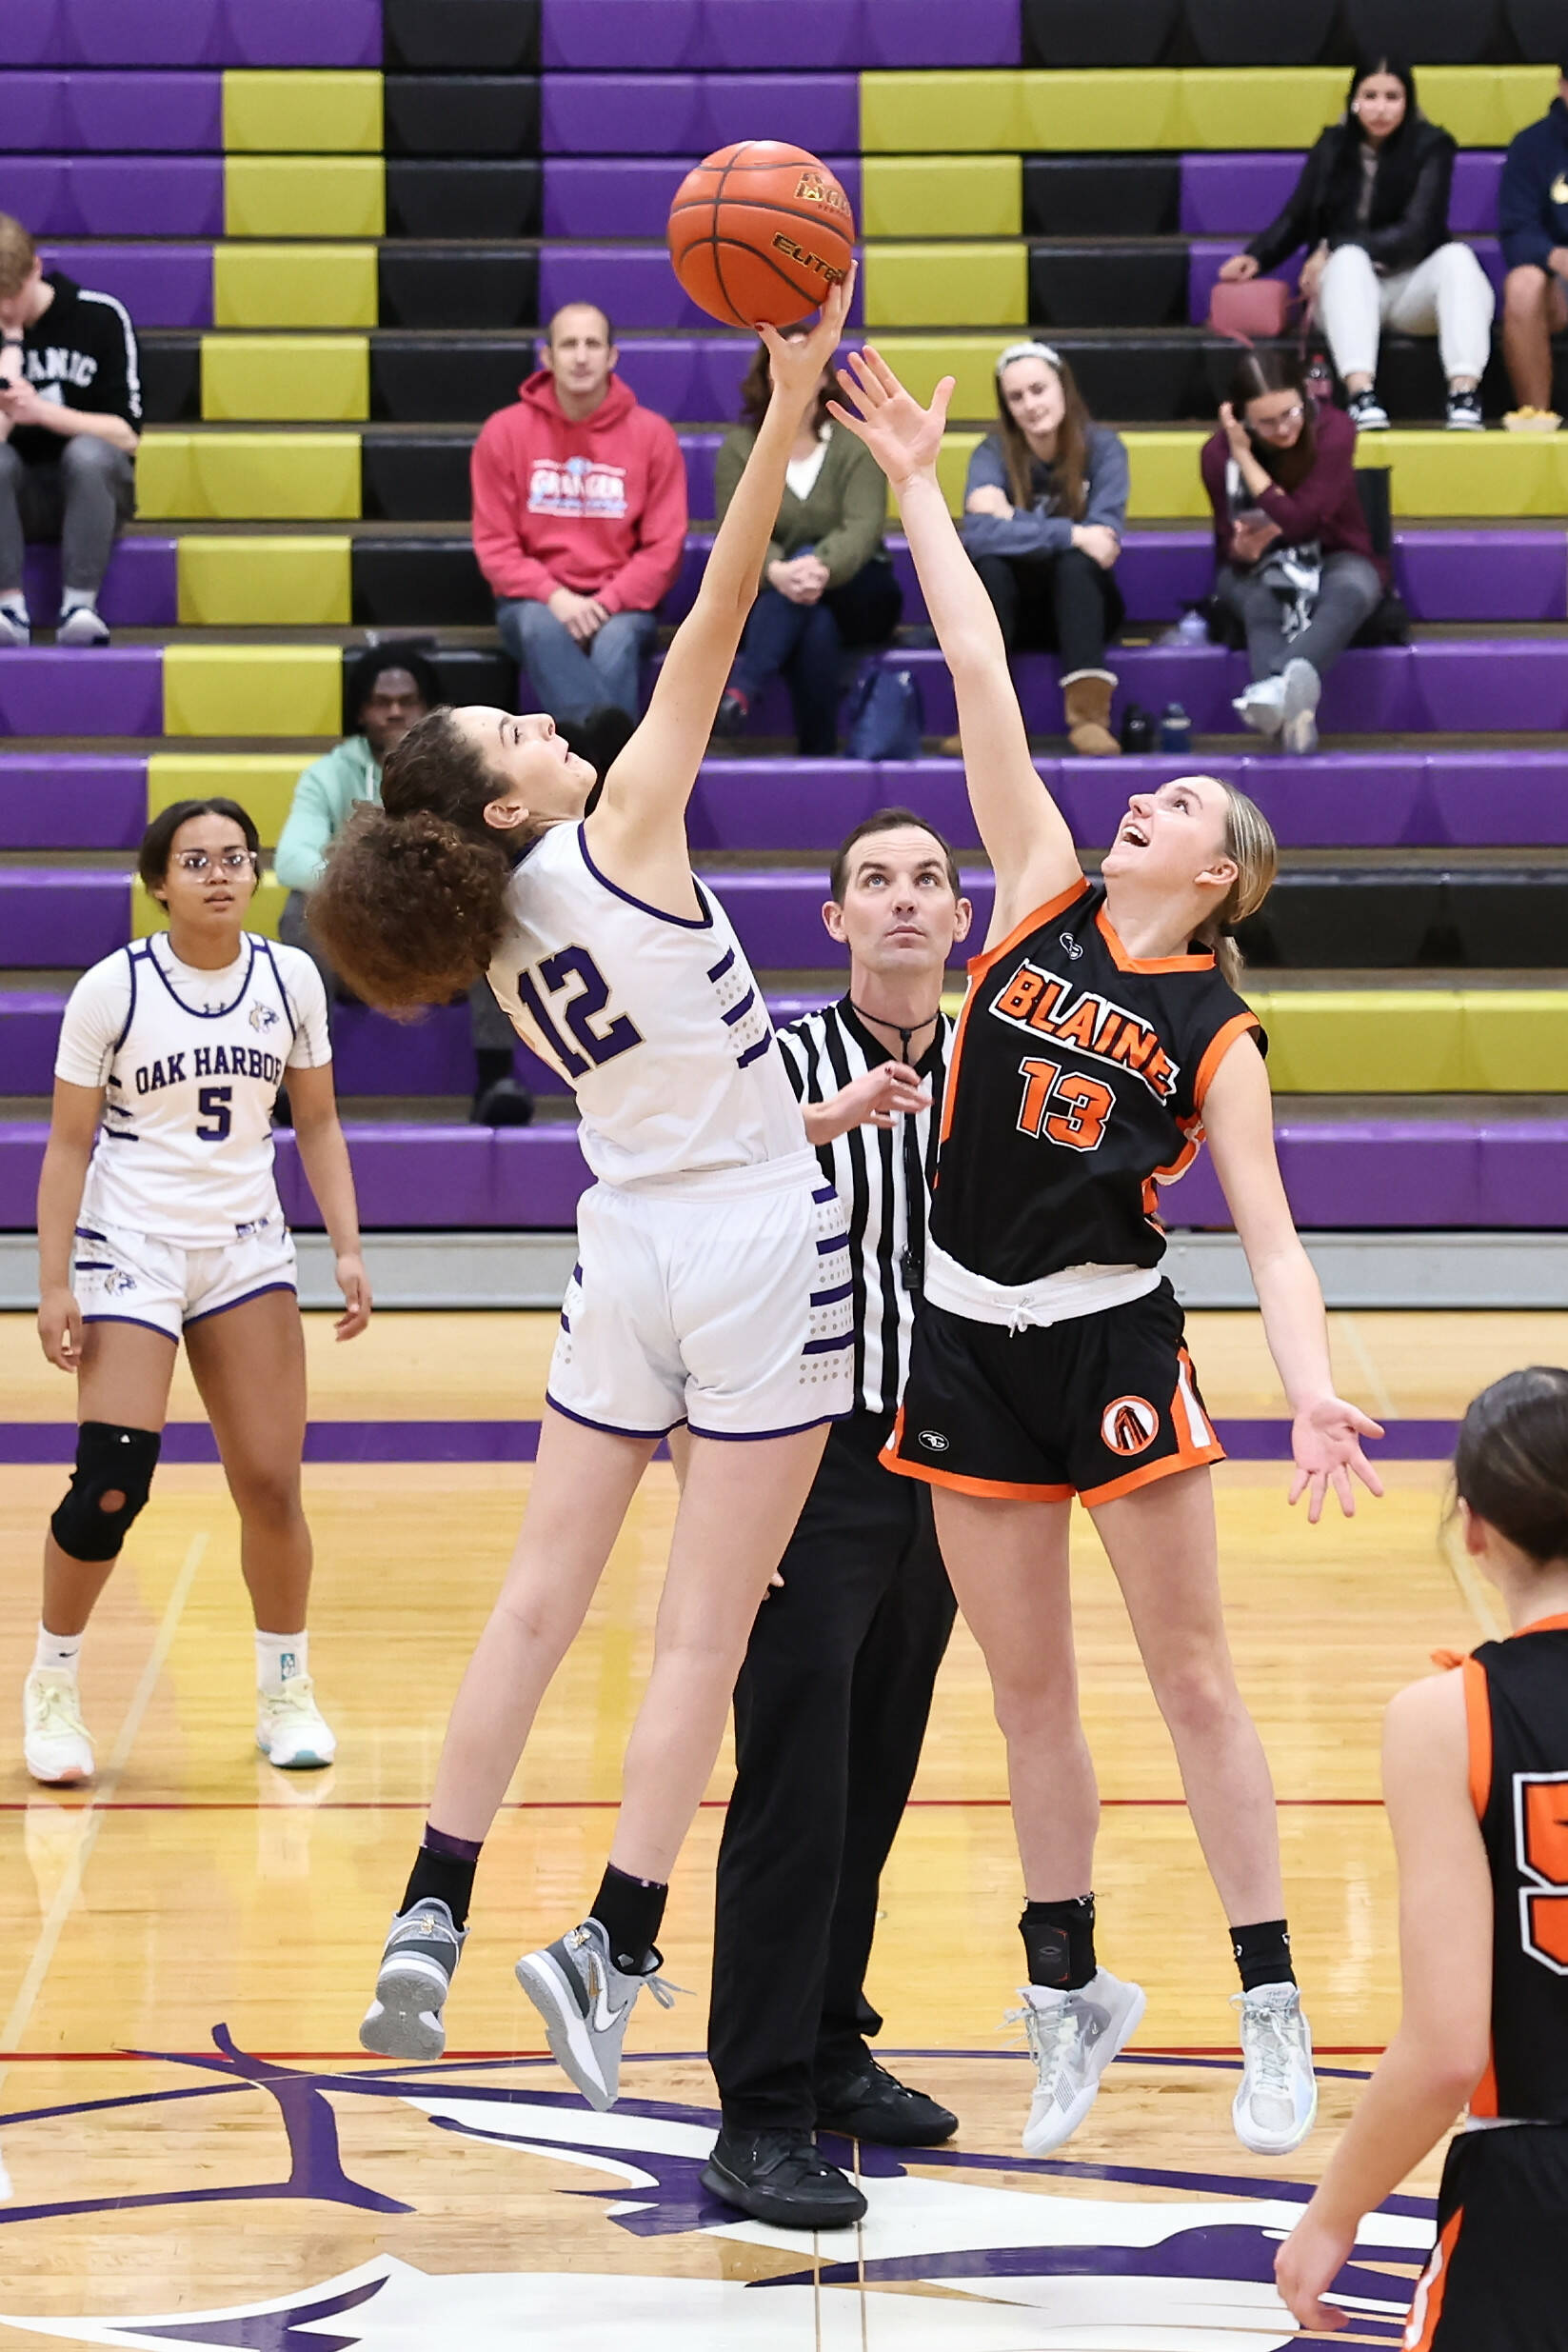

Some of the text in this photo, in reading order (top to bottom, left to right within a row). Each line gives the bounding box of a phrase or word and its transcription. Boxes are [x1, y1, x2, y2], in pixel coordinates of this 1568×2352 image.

[772, 232, 840, 282] ELITE
[26, 346, 98, 389] ANIC
[517, 942, 646, 1080] 12
[989, 958, 1181, 1106] BLAINE
[135, 1052, 187, 1095] OAK
[195, 1086, 232, 1142] 5
[1016, 1056, 1117, 1152] 13
